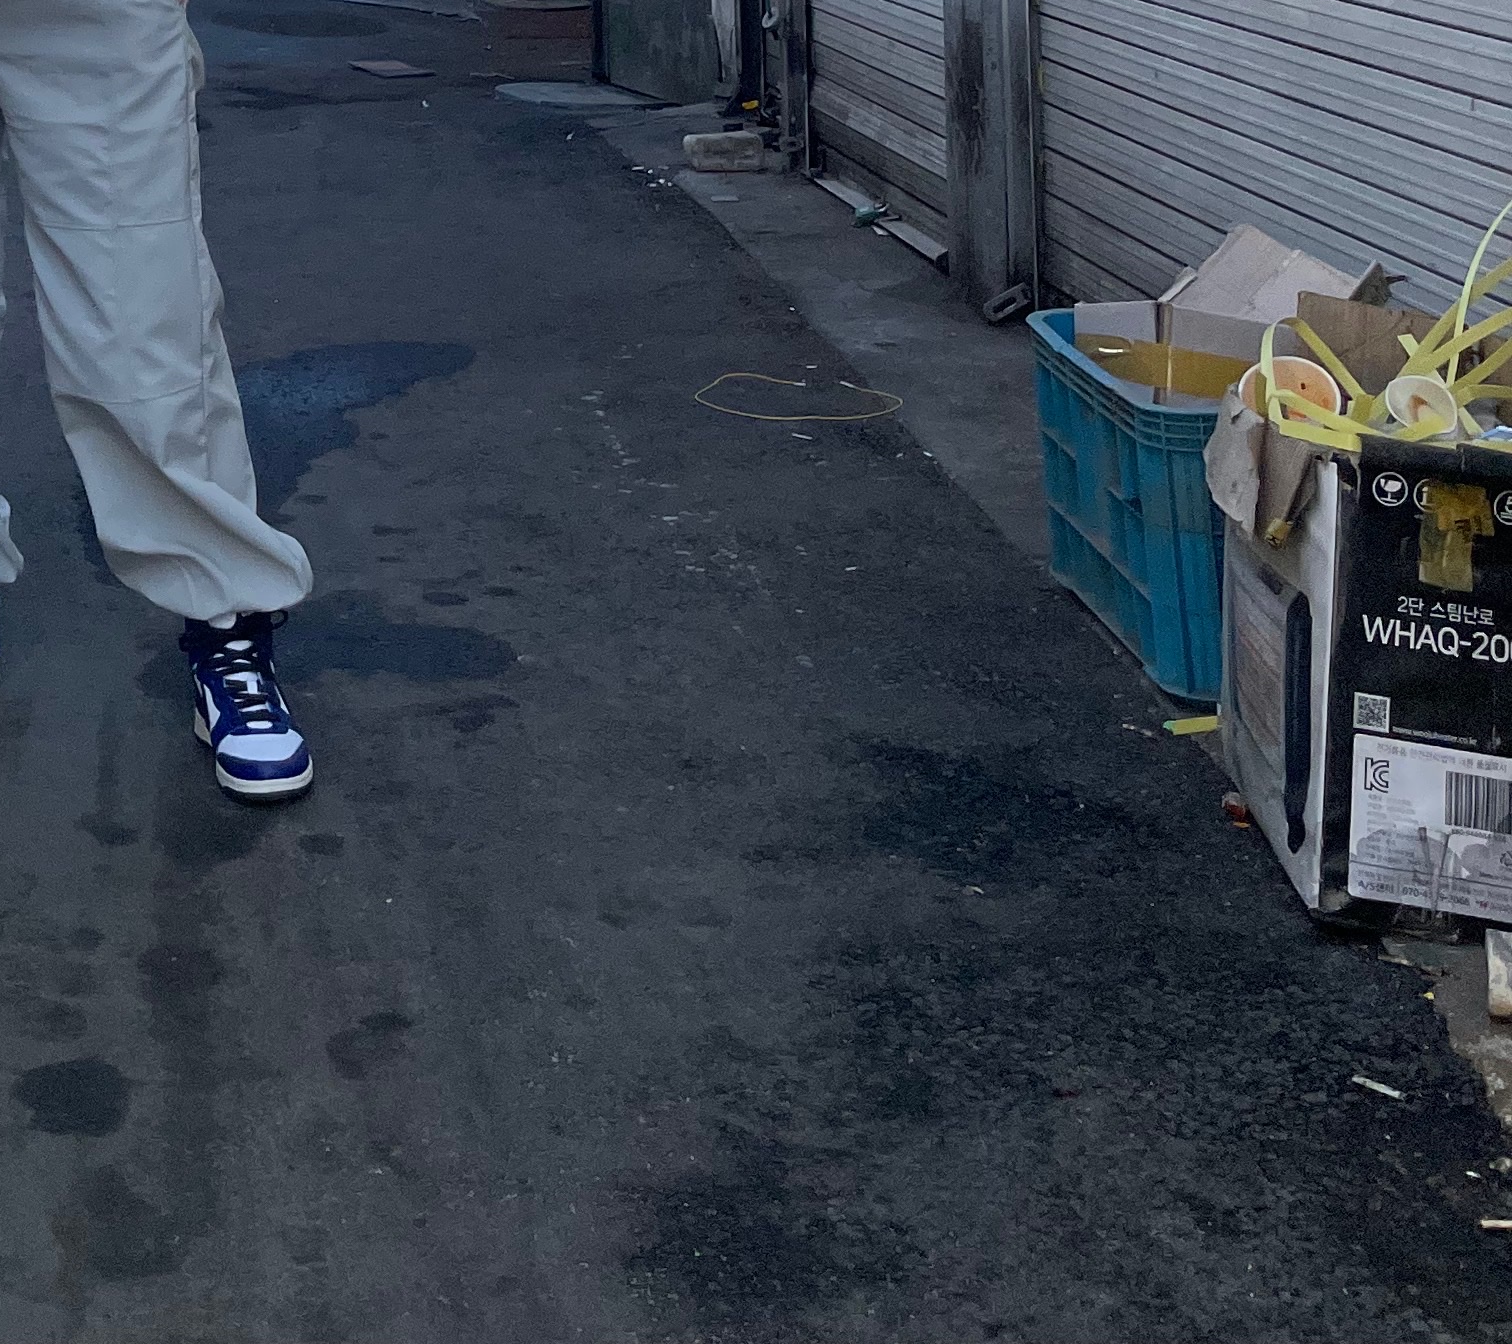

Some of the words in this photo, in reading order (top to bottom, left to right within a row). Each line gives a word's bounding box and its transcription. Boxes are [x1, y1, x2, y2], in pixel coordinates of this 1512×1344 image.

[1397, 595, 1425, 617] 2단
[1429, 601, 1496, 626] 스팀난로
[1362, 614, 1512, 663] WHAQ-20
